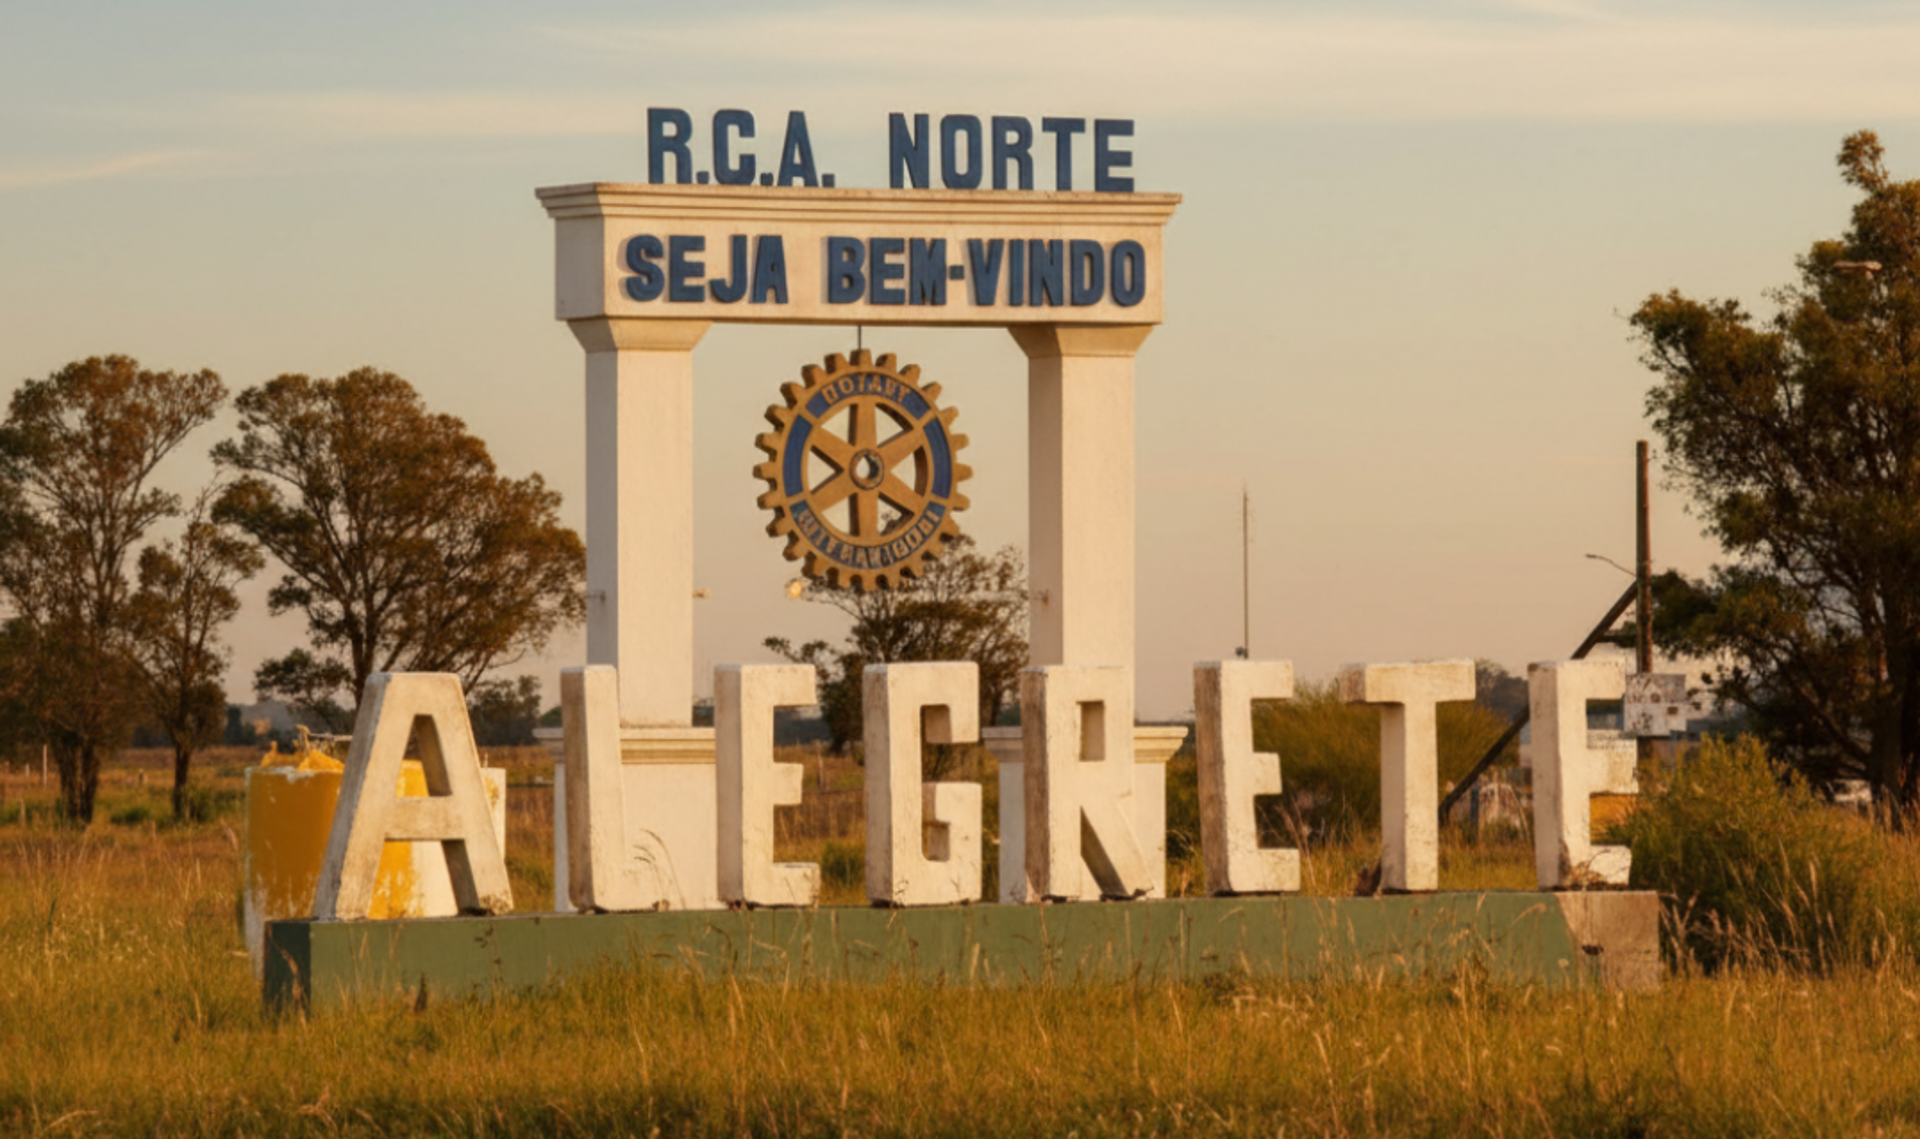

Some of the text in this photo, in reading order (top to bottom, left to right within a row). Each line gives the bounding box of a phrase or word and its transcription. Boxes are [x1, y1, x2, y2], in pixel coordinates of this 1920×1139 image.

[888, 112, 1136, 193] NORTE
[622, 234, 1147, 307] SEJA BEM-VINDO
[314, 659, 1639, 920] ALEGRETE
